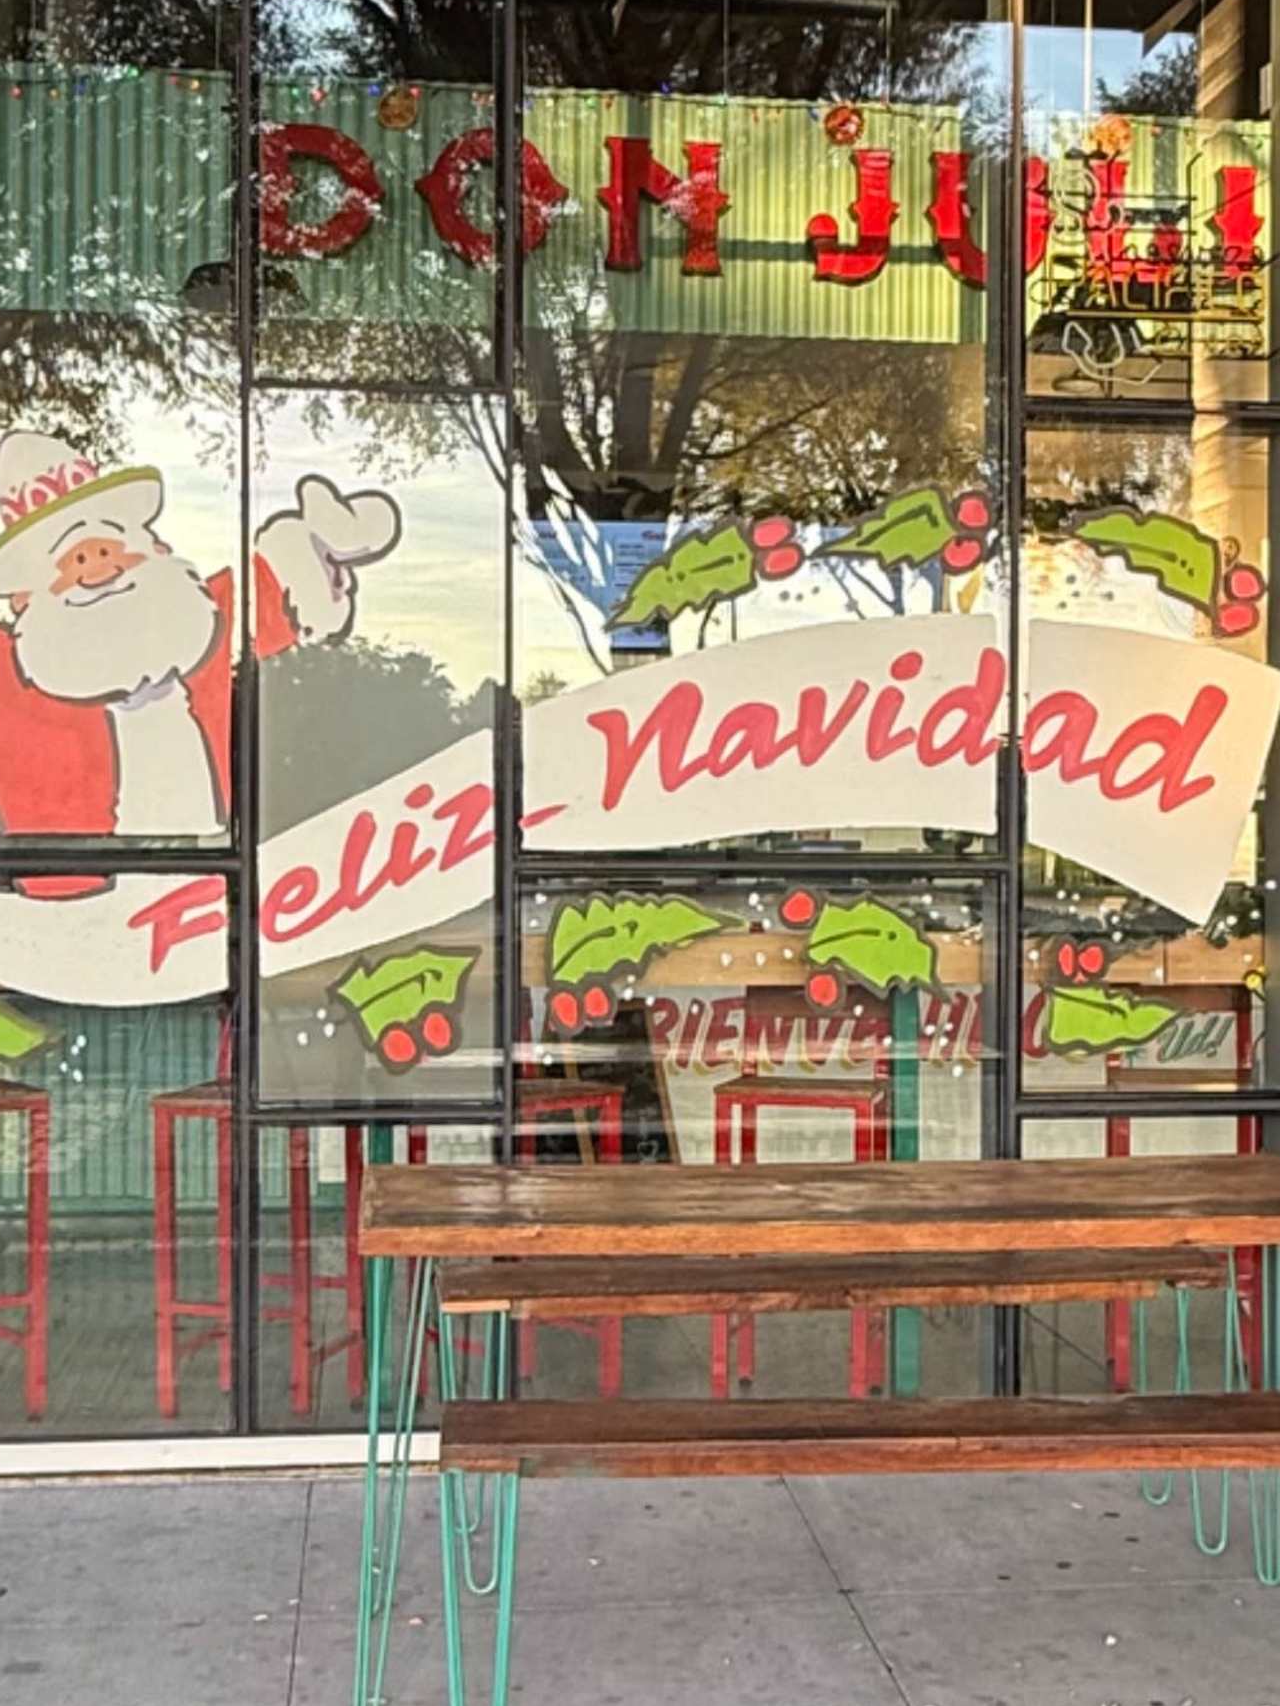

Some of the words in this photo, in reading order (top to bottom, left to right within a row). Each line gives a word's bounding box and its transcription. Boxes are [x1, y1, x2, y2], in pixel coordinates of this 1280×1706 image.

[258, 122, 731, 277] DON
[128, 782, 567, 974] Feliz
[586, 648, 1228, 813] Navidad
